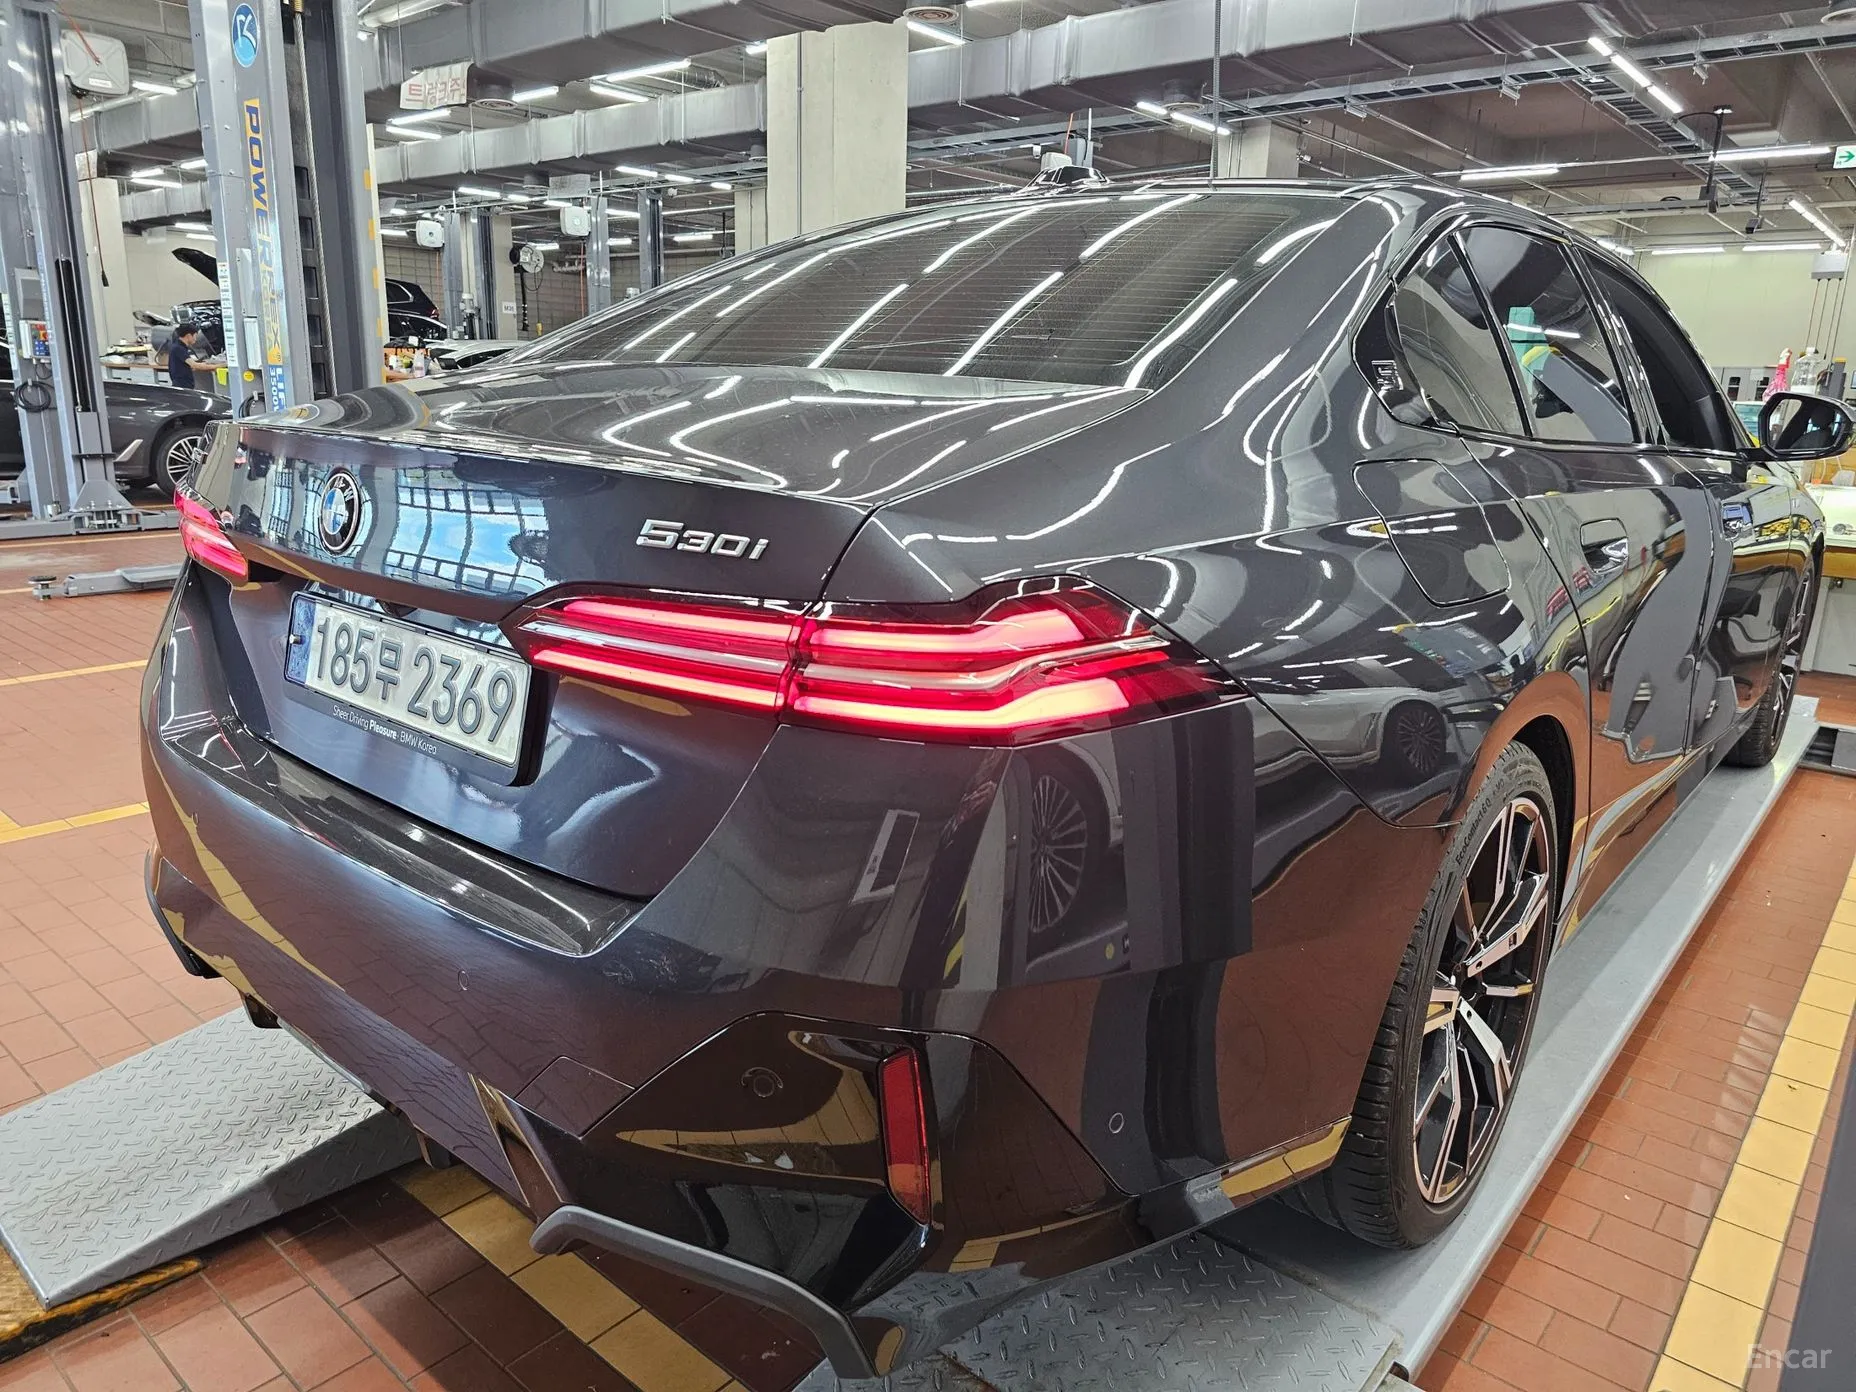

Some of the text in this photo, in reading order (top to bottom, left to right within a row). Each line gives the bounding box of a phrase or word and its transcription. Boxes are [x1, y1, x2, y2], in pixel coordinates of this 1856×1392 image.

[276, 366, 286, 409] LIF
[636, 519, 769, 560] 530i
[317, 617, 515, 742] 185무 2369
[333, 705, 437, 754] Sheer Driving Pleasure BMW Korea
